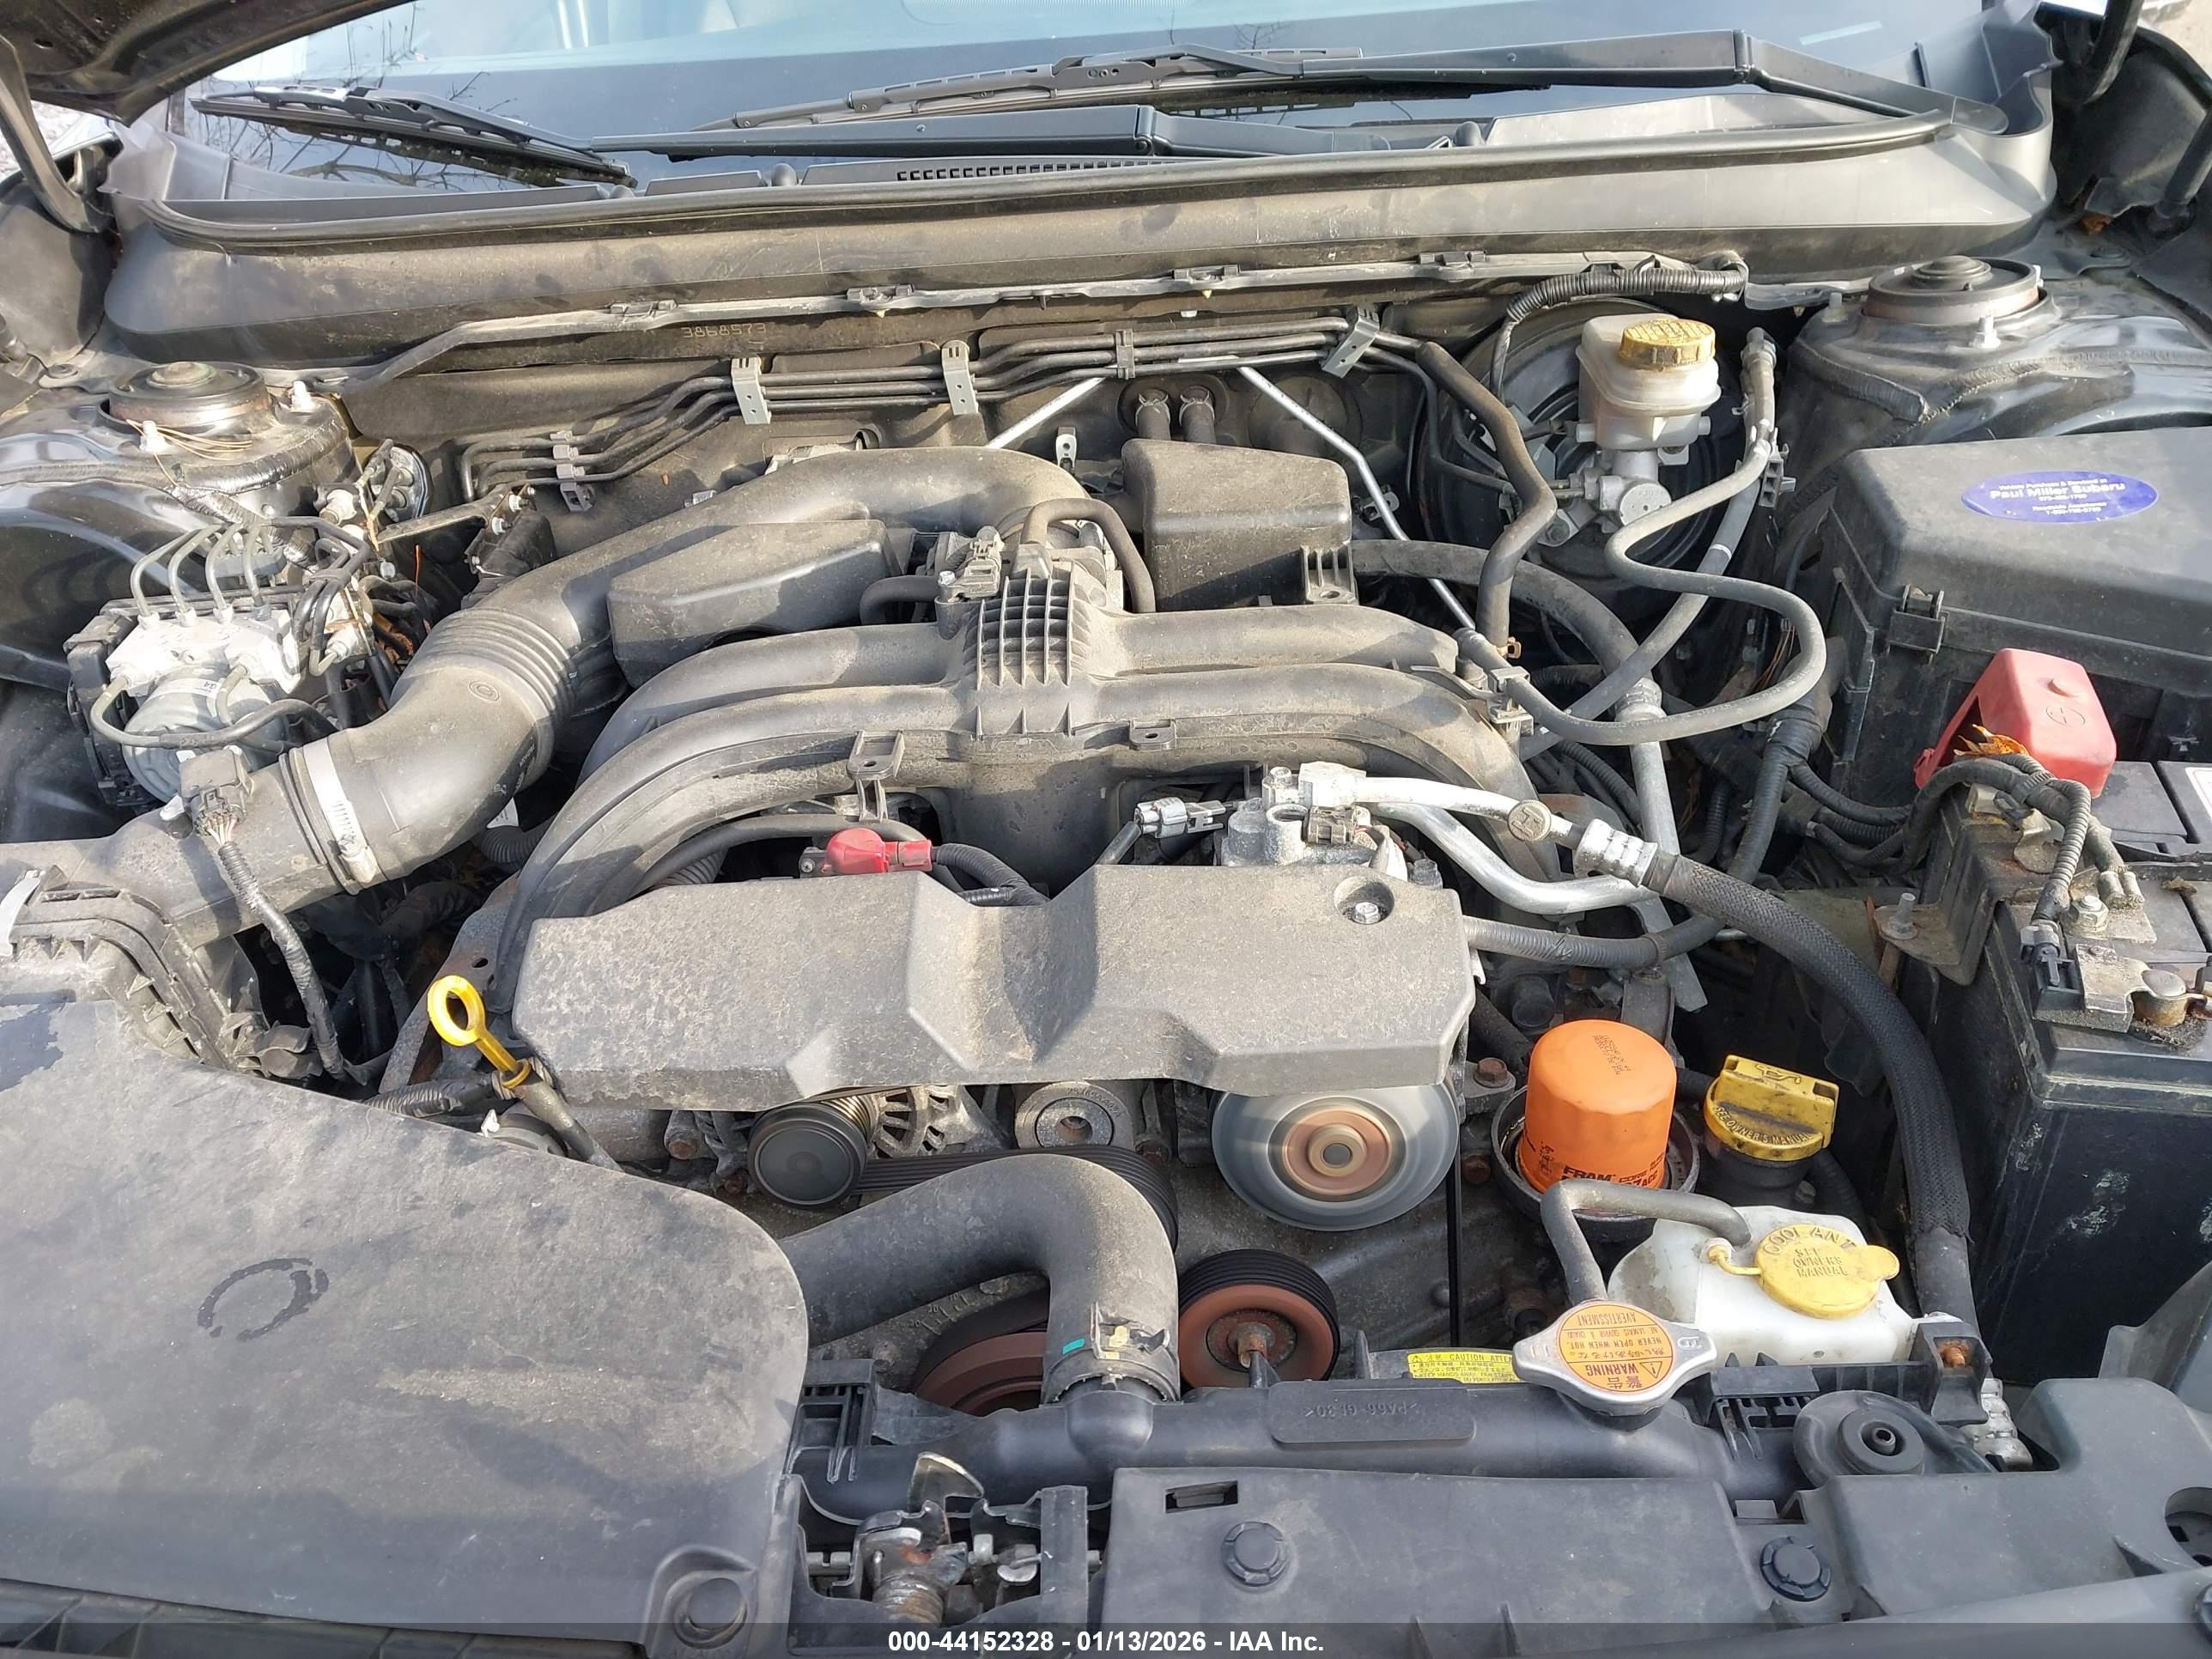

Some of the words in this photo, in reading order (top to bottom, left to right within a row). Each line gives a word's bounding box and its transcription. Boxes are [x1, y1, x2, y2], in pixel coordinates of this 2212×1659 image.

[1990, 489, 2024, 500] Paul
[2027, 485, 2069, 497] Miller
[2071, 482, 2126, 494] Subaru
[1713, 1106, 1729, 1121] SEE
[1728, 1120, 1768, 1144] OWNER'S
[1771, 1131, 1814, 1146] MANUAL
[1563, 1164, 1613, 1182] FRAM
[1763, 1225, 1856, 1255] COOLANT
[1794, 1247, 1821, 1257] SEE
[1796, 1265, 1849, 1278] MANUAL
[1623, 1328, 1644, 1336] JAMAIS
[1589, 1340, 1609, 1349] WHEN
[1638, 1337, 1662, 1346] NEVER
[1585, 1363, 1639, 1376] WARNING
[1607, 1376, 1642, 1389] 警告
